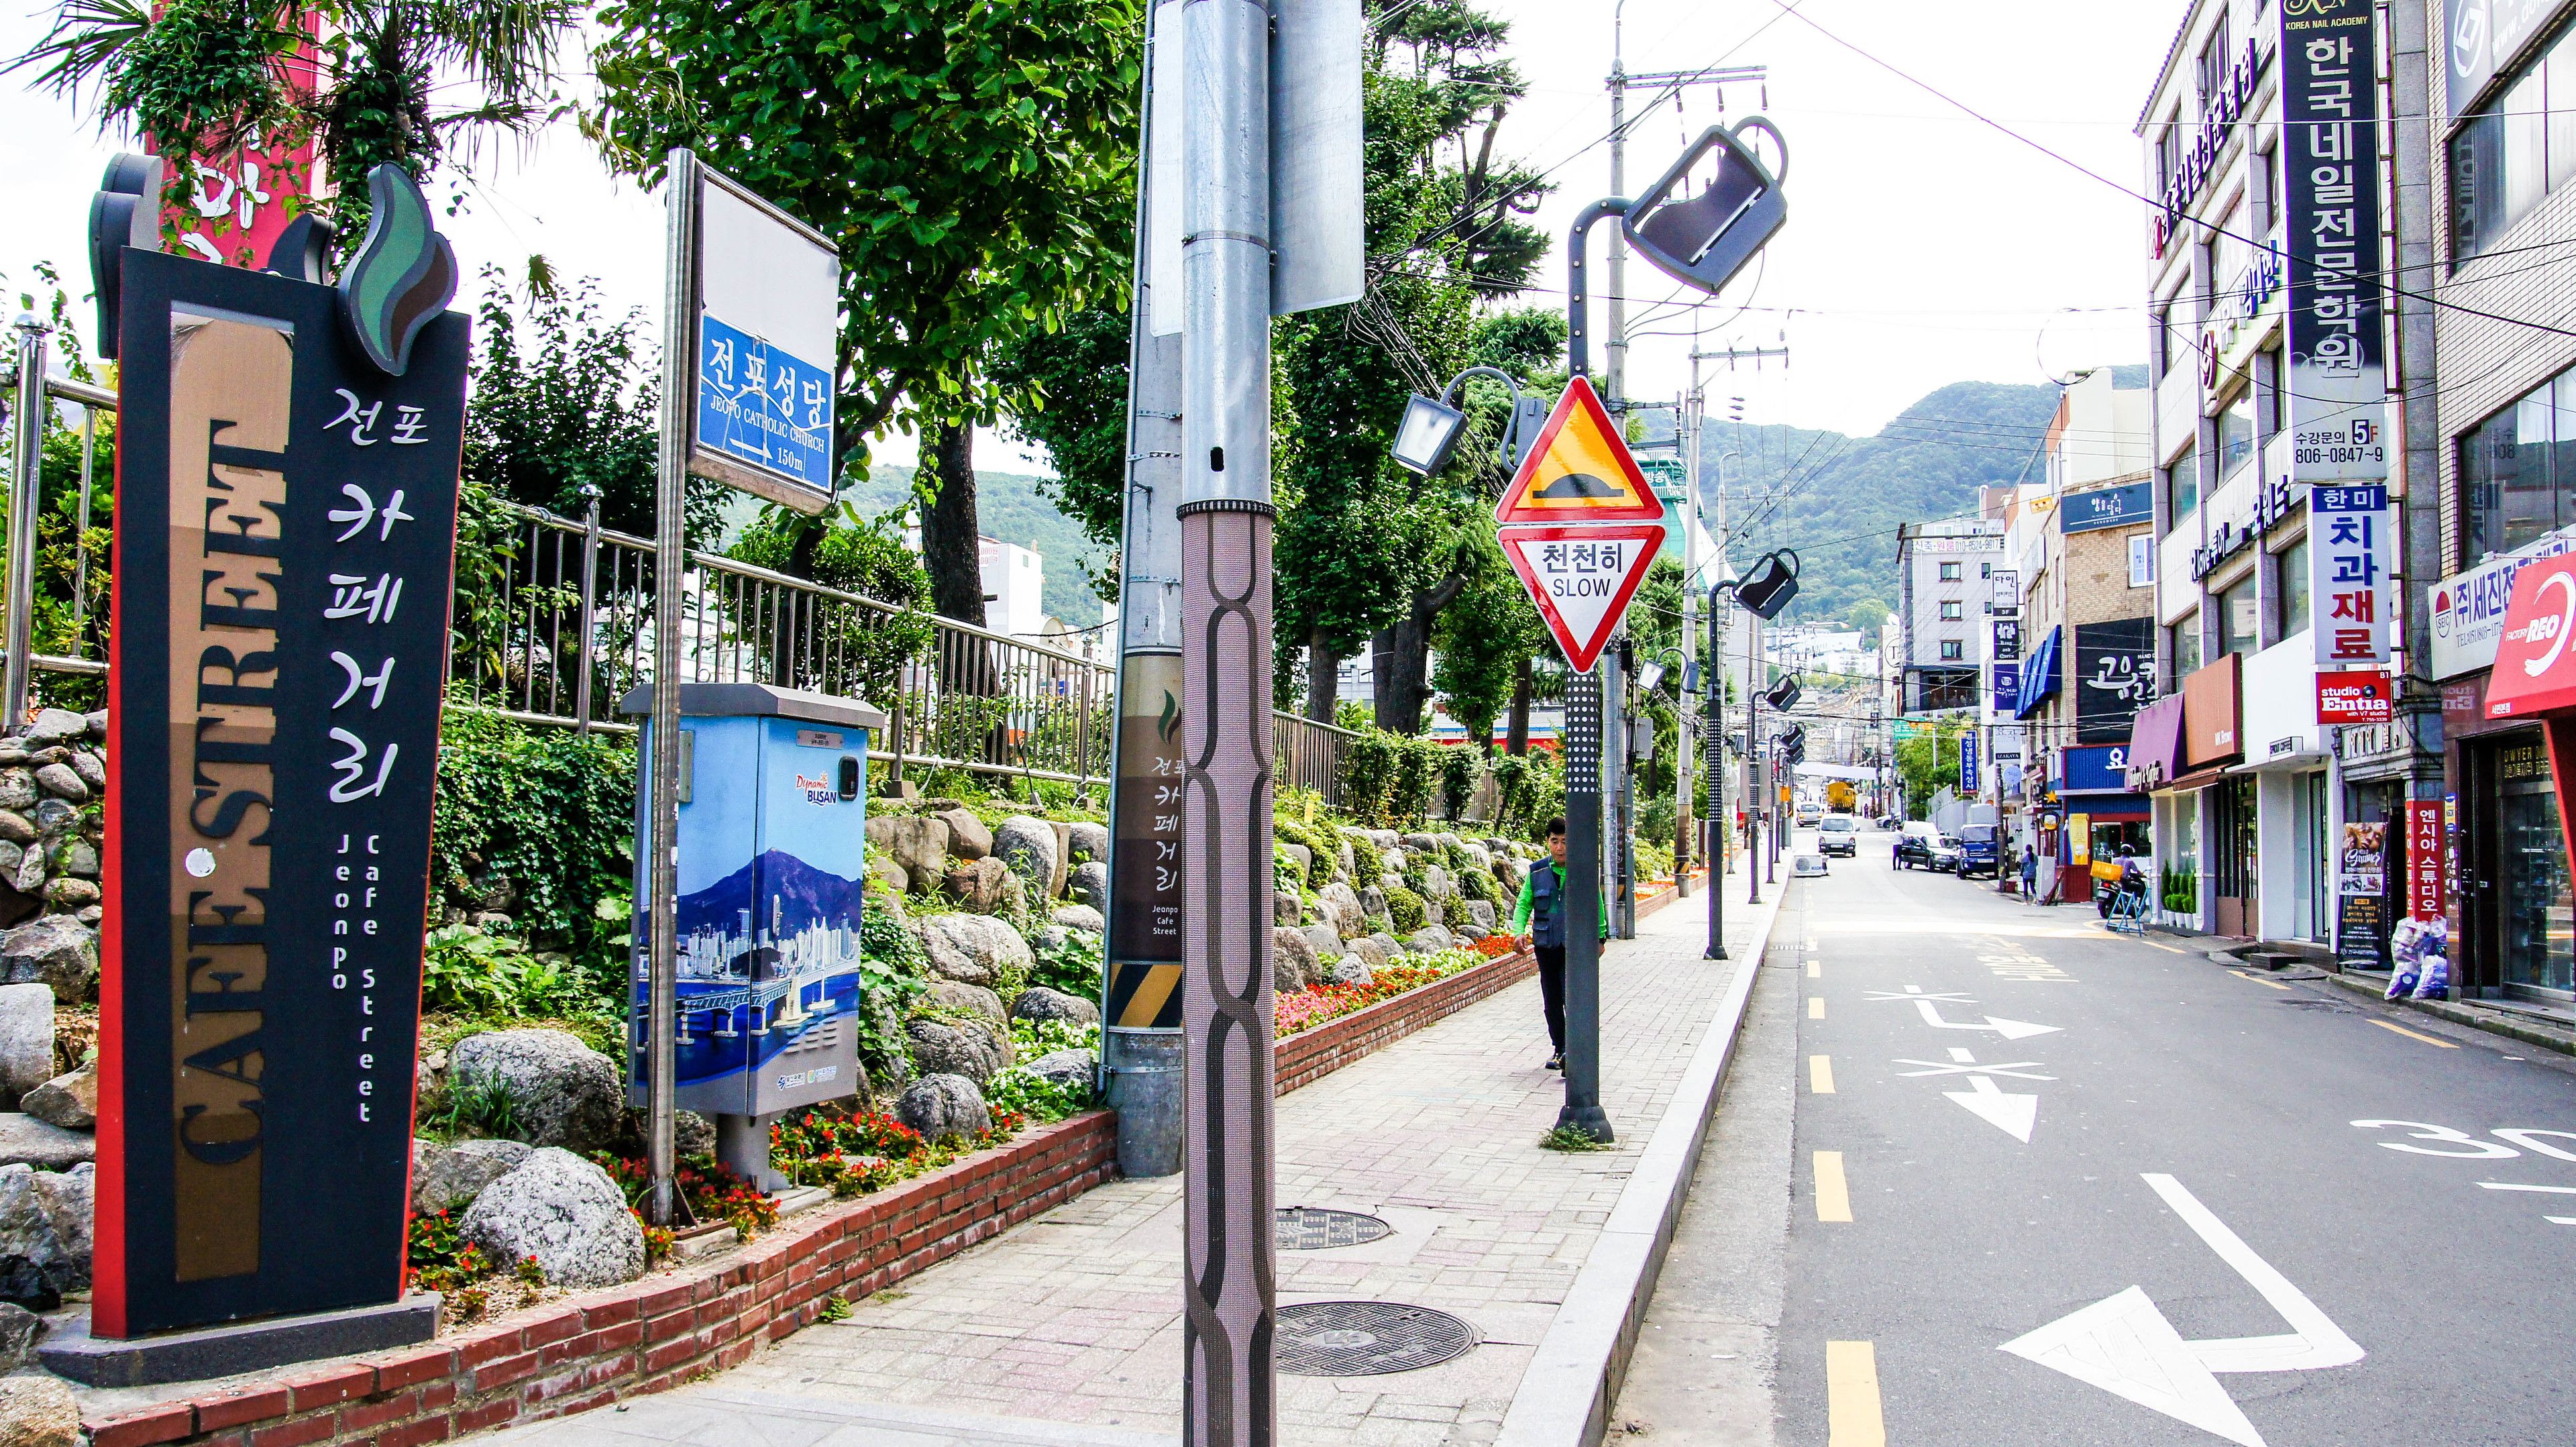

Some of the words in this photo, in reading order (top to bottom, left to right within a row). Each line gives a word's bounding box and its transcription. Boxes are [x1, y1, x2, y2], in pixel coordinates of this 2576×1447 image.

[2286, 21, 2310, 30] KOREA
[2312, 19, 2328, 28] NAIL
[2331, 16, 2368, 27] ACADEMY
[2306, 36, 2361, 378] 한국네일전문학원
[709, 337, 826, 427] 전포성당
[323, 388, 429, 447] 전포
[790, 428, 824, 453] CHURCH
[2296, 431, 2345, 444] 수강문의
[777, 447, 803, 472] 150m
[2296, 447, 2383, 464] 806-0847~9
[2323, 489, 2375, 509] 한미
[1542, 542, 1623, 574] 천천히
[1553, 578, 1611, 598] SLOW
[2329, 515, 2379, 660] 치과재료
[189, 417, 289, 845] STREET
[2526, 614, 2561, 643] REO
[325, 483, 415, 804] 카페거리
[2322, 687, 2360, 696] studio
[2322, 697, 2388, 711] Entia
[796, 775, 828, 792] Dynamic
[808, 790, 837, 804] BUSAN
[1154, 784, 1183, 892] 카페거리
[2419, 809, 2437, 852] 엔시아
[362, 833, 380, 937] Cafe
[2420, 856, 2438, 912] 스튜디오
[331, 833, 350, 991] Jeonpo
[1152, 905, 1178, 915] Jeonpo
[1157, 917, 1174, 926] Cafe
[1152, 927, 1177, 936] Street
[181, 886, 271, 1167] CAFE
[358, 967, 377, 1124] Street
